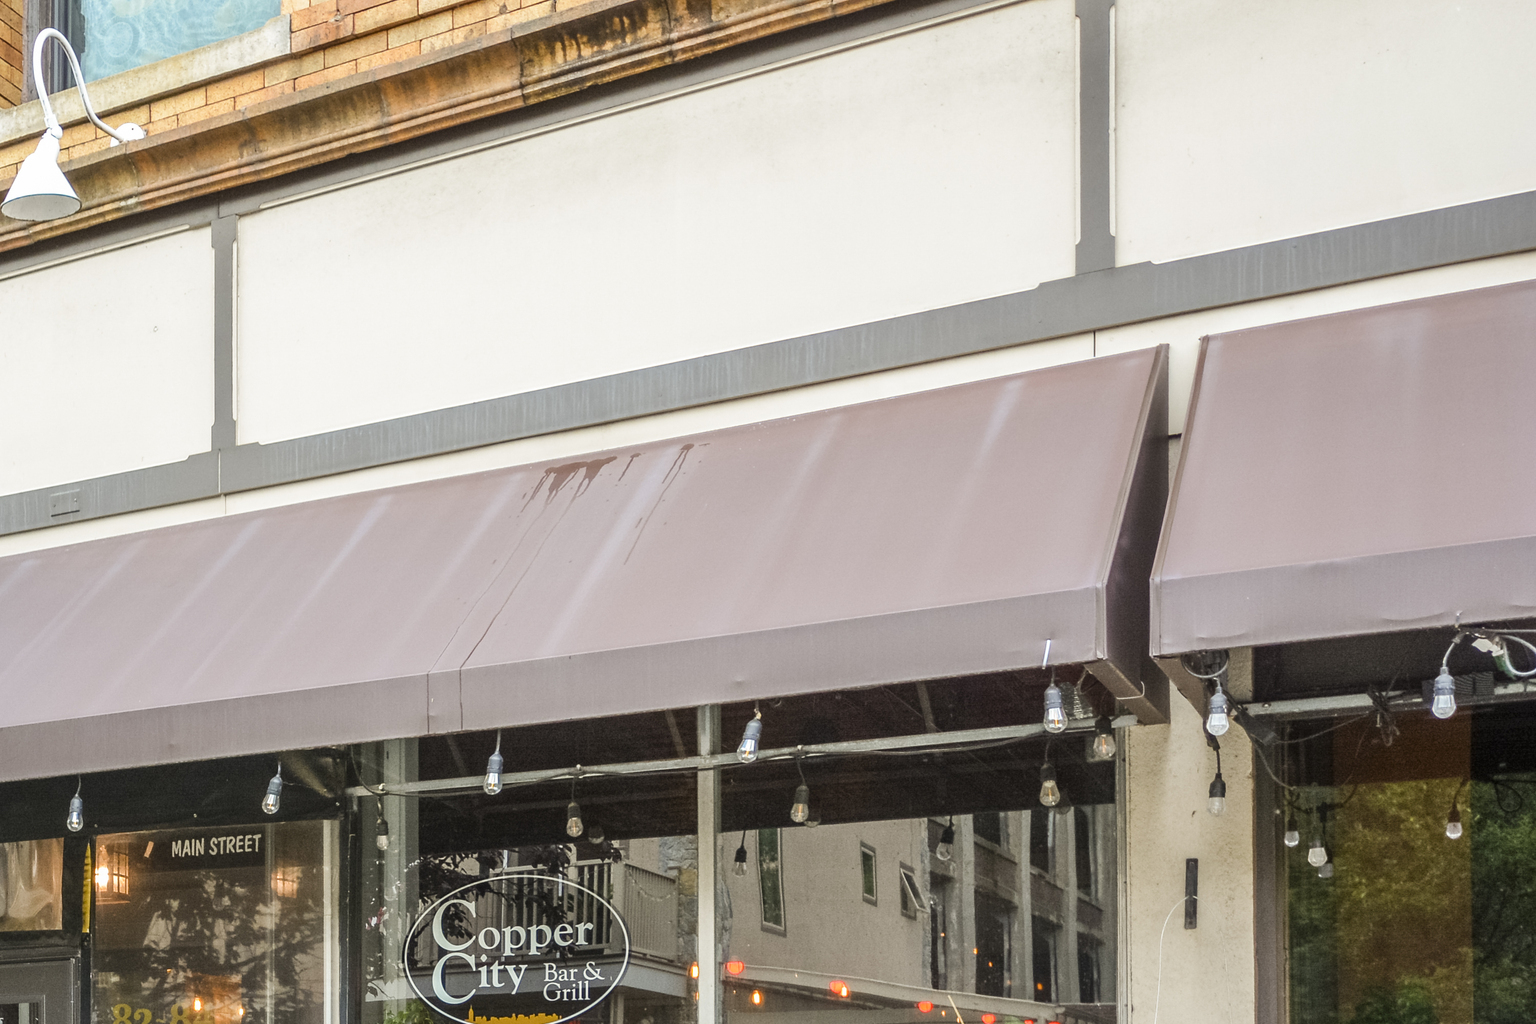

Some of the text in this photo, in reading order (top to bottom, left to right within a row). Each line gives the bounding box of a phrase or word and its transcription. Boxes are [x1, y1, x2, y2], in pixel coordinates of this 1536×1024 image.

[171, 834, 262, 858] MAIN STREET
[432, 899, 594, 957] Copper
[432, 952, 528, 1005] City
[543, 961, 605, 982] Bar &
[543, 981, 591, 1002] Grill
